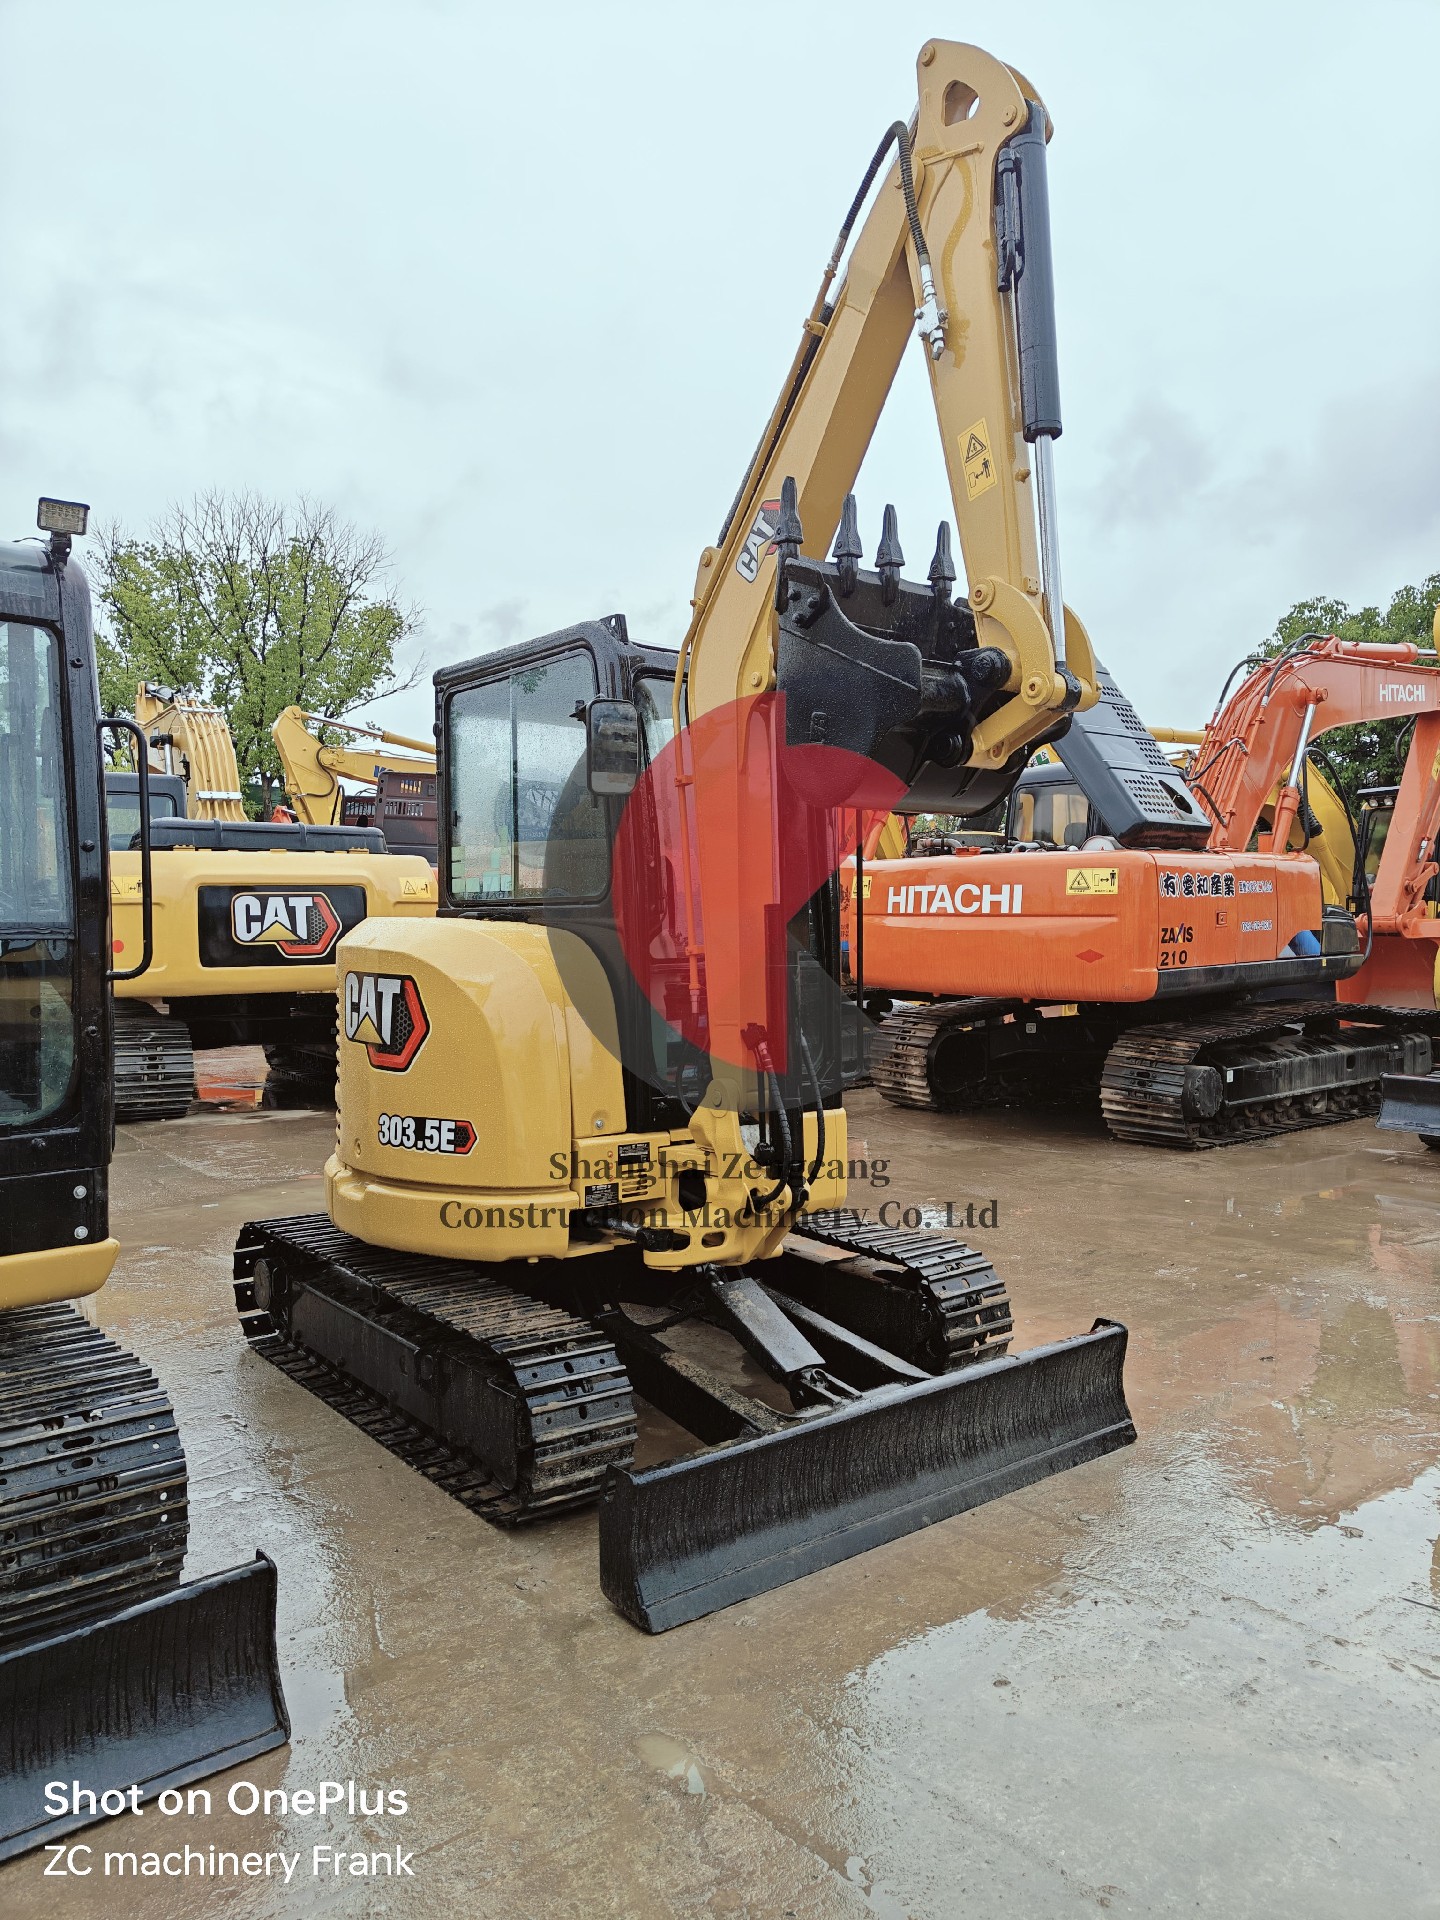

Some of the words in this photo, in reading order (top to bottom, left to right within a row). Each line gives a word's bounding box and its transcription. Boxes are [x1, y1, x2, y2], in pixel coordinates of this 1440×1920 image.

[736, 510, 775, 582] CAT
[1379, 683, 1426, 702] HITACHI
[887, 884, 1023, 914] HITACHI
[234, 895, 313, 941] CAT
[1160, 923, 1194, 944] ZAXIS
[1160, 950, 1188, 967] 210
[345, 972, 402, 1045] CAT
[378, 1113, 456, 1152] 303.5E
